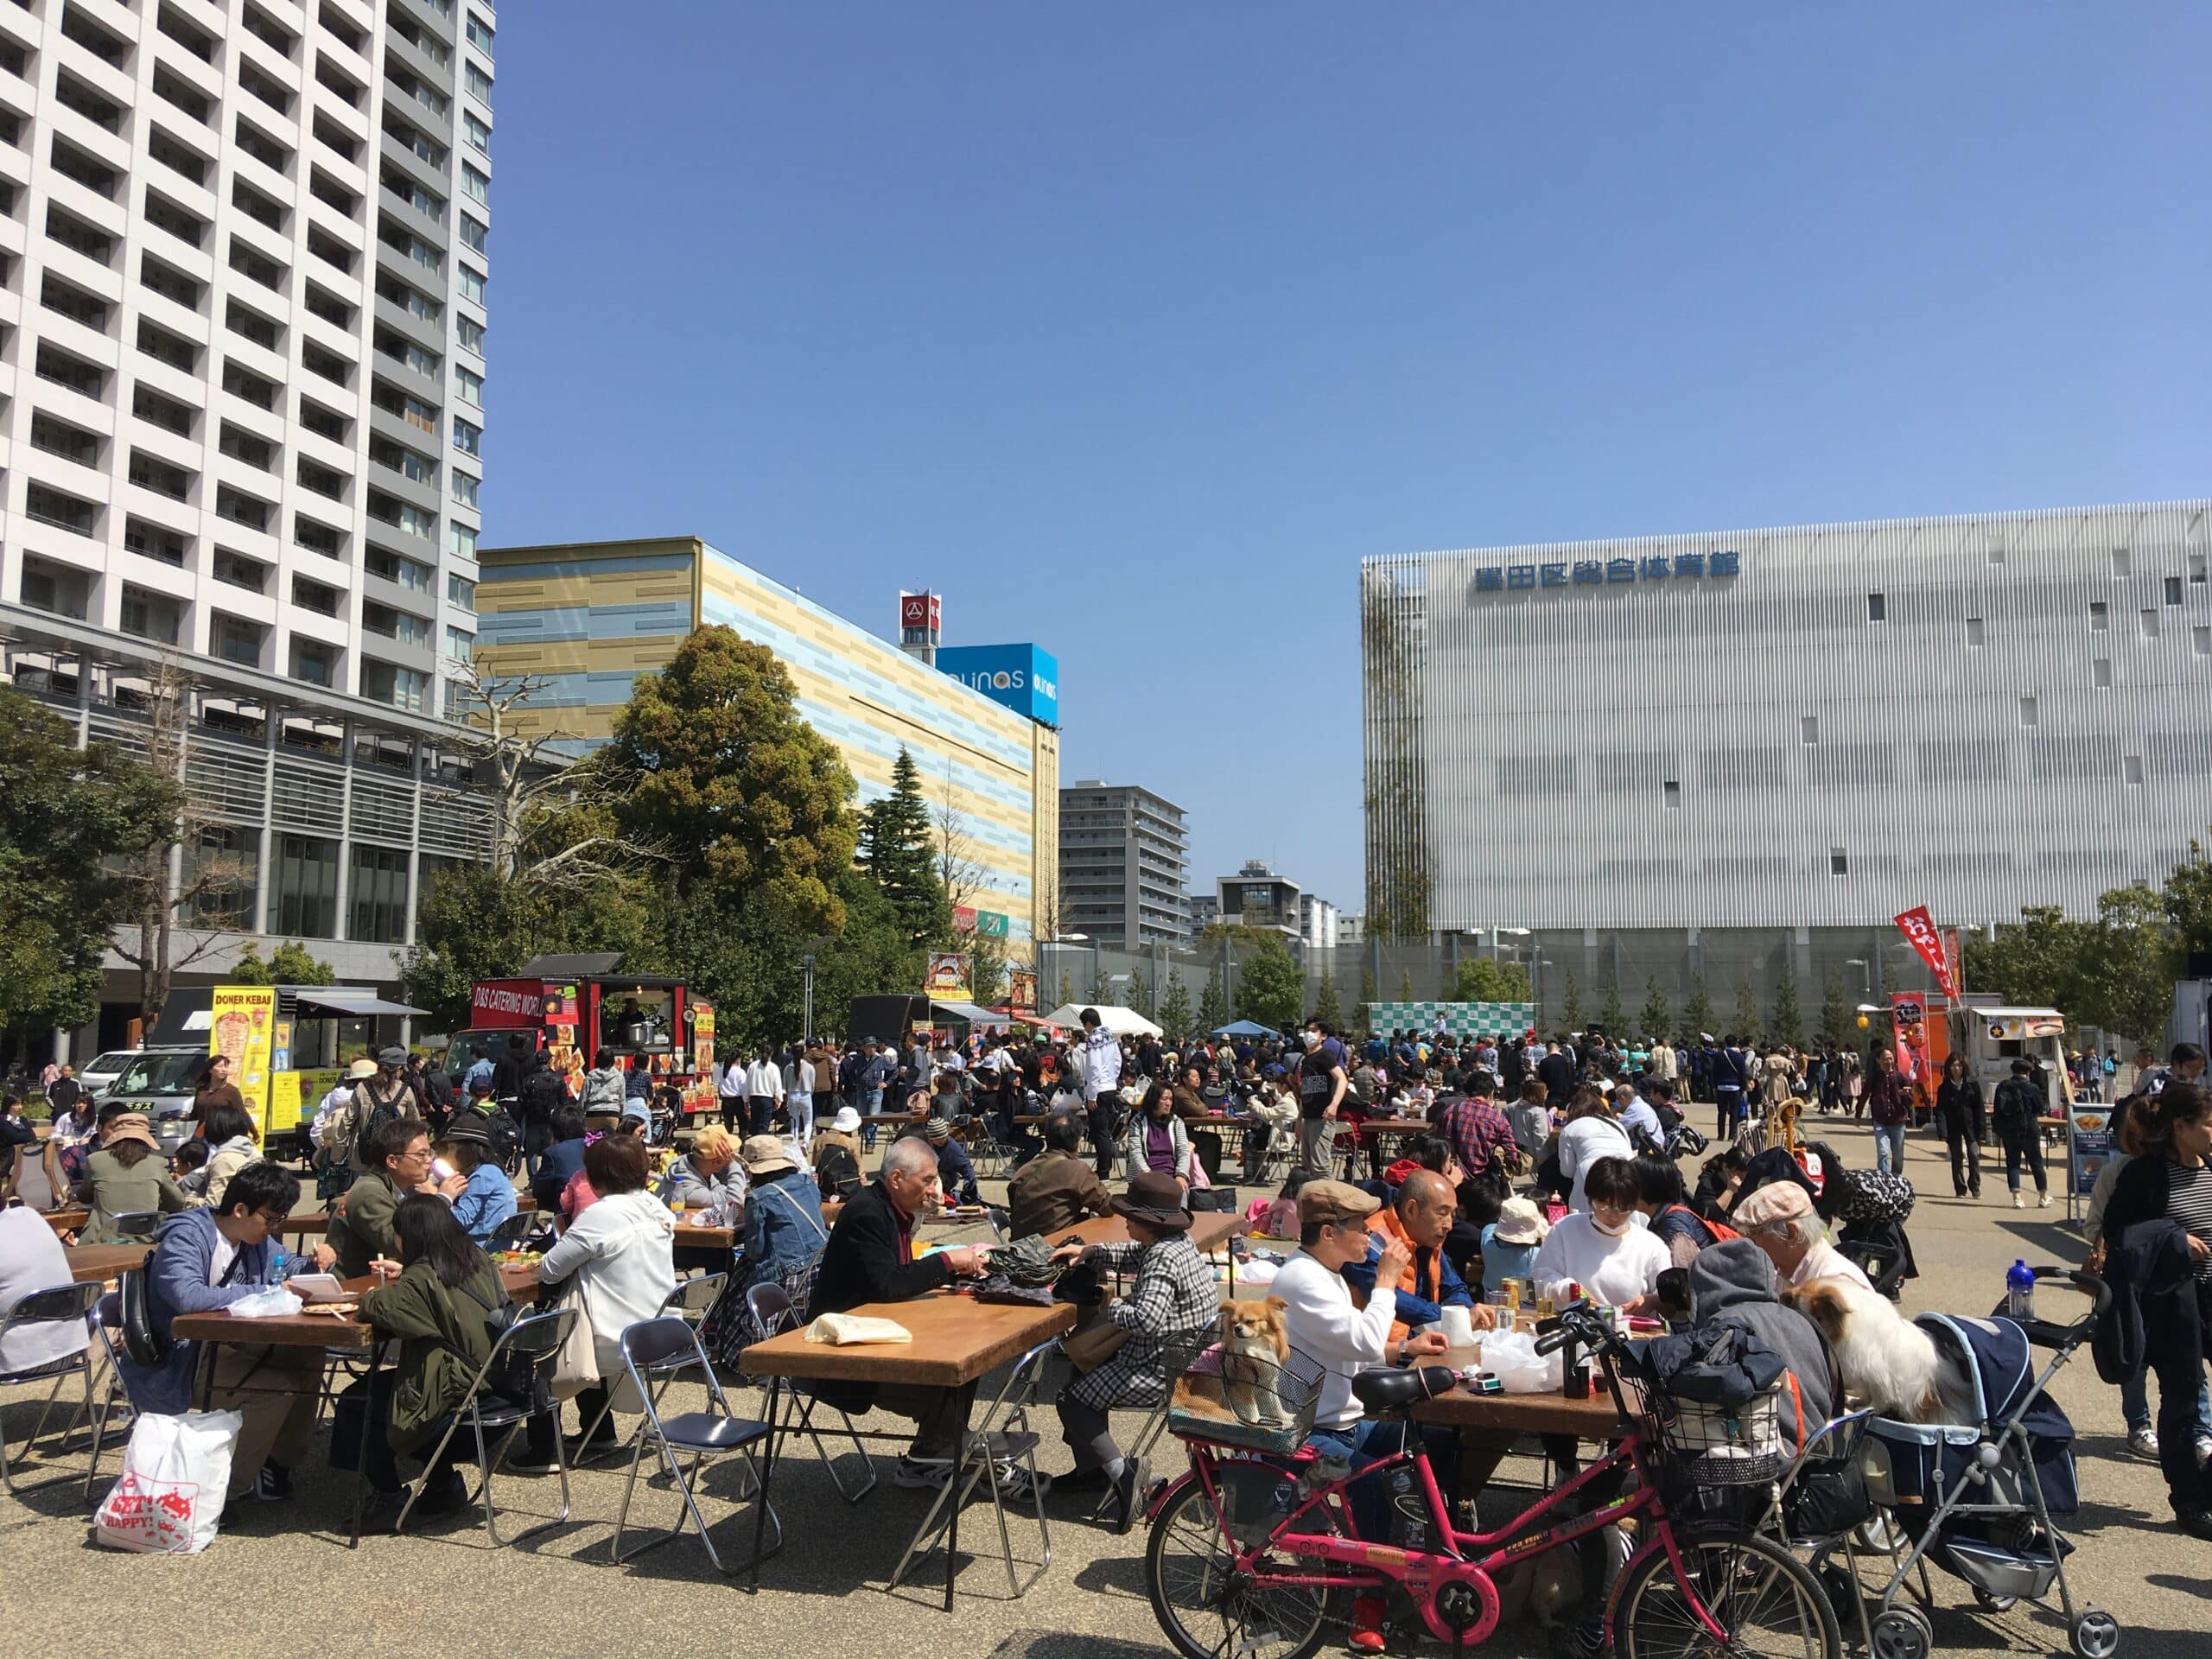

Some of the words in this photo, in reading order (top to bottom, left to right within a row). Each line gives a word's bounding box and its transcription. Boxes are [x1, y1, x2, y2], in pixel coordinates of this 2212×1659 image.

[1476, 551, 1738, 591] 墨田区総合体育館
[215, 995, 244, 1005] DONER
[245, 995, 271, 1006] KEBAB
[488, 988, 521, 1014] CATERING
[520, 995, 545, 1018] WORLD
[111, 1495, 154, 1514] GET!
[106, 1516, 154, 1529] HAPPY!
